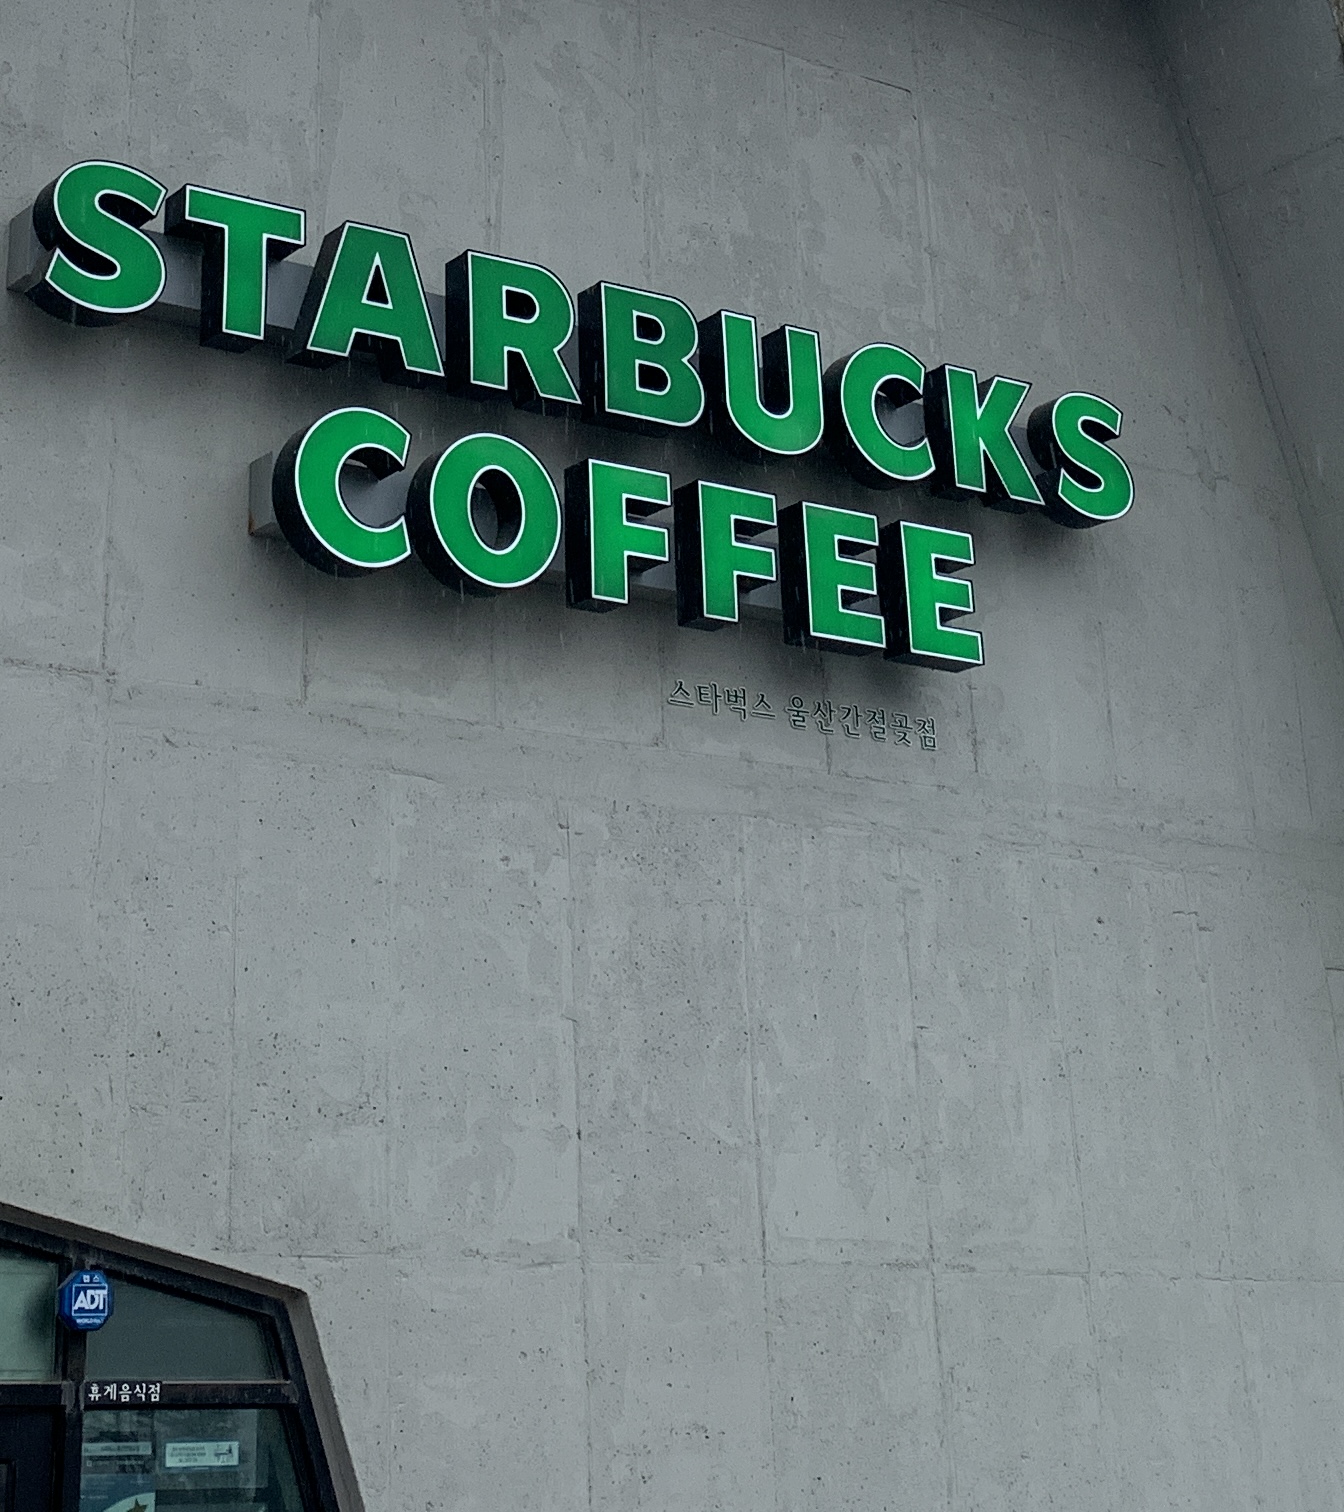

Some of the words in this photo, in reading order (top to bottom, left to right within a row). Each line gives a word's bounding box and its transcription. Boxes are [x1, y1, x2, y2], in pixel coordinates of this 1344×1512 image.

[44, 159, 1137, 523] STARBUCKS
[293, 405, 987, 668] COFFEE
[668, 680, 776, 720] 스타벅스
[785, 696, 937, 750] 울산간절곶점
[73, 1289, 107, 1310] ADT
[88, 1383, 161, 1402] 휴게음식점
